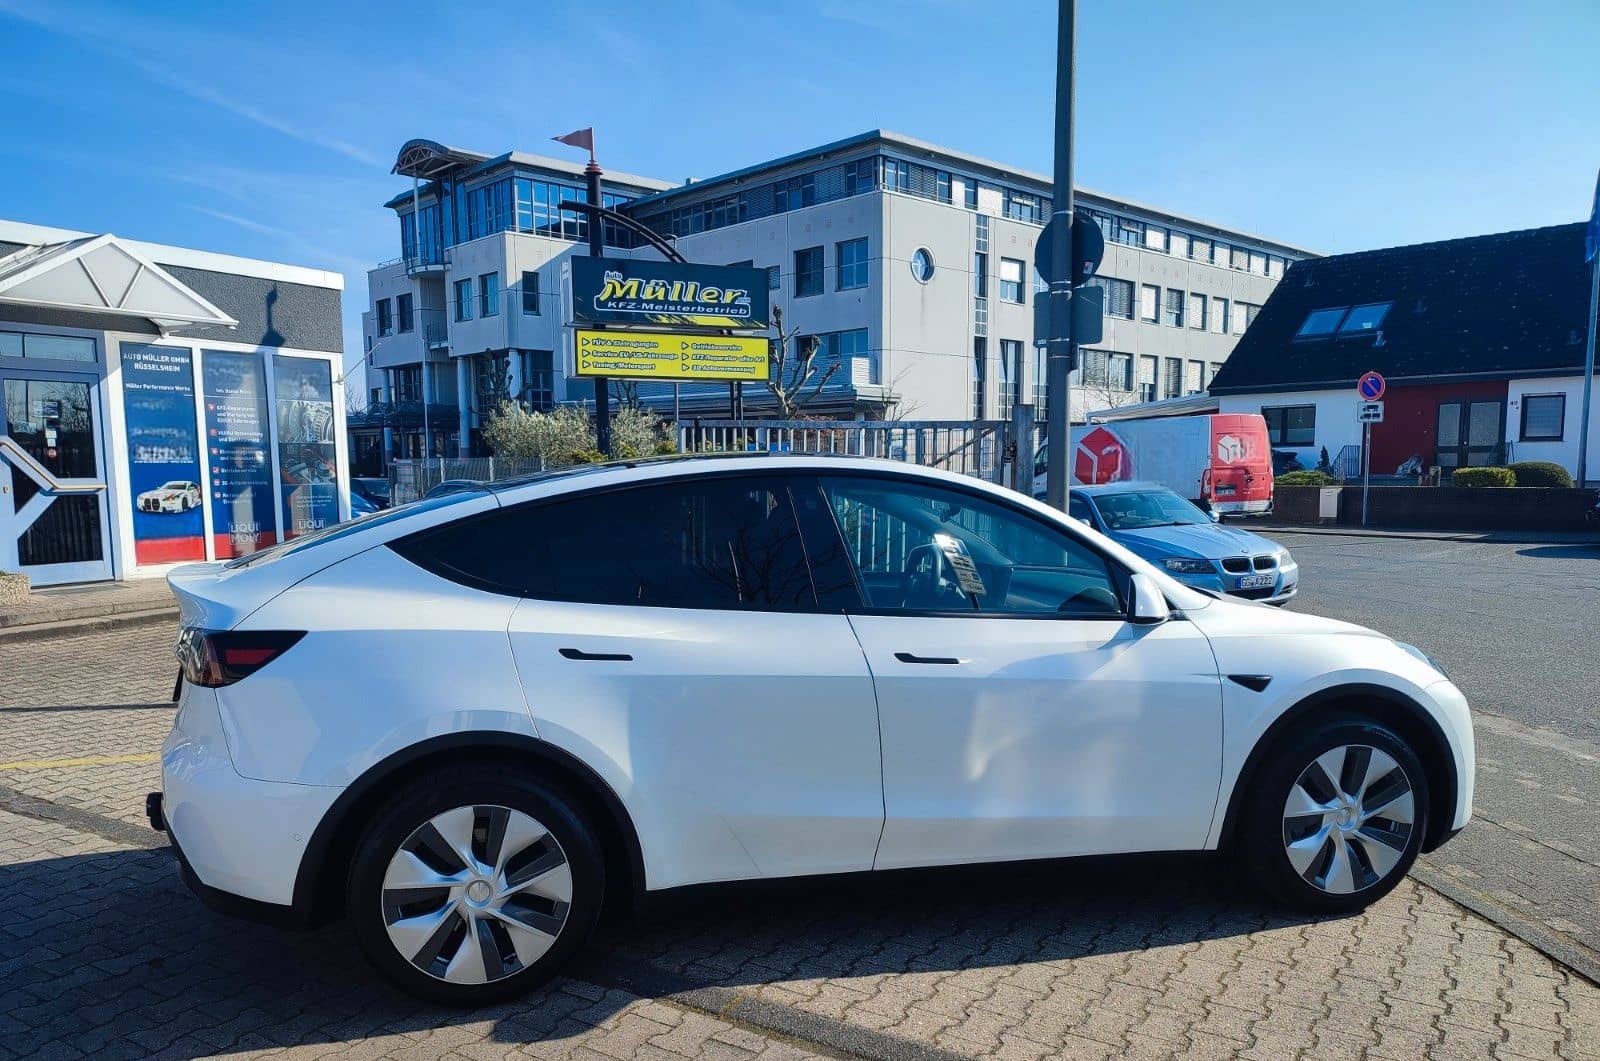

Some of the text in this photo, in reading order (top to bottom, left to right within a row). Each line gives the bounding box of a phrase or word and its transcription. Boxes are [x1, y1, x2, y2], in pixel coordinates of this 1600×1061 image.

[604, 270, 623, 280] Auto
[600, 278, 748, 305] Müller
[607, 301, 747, 315] KFZ-Meisterbetrieb
[592, 337, 606, 346] TÜV
[123, 352, 141, 361] AUTO
[142, 353, 170, 363] MÜLLER
[592, 350, 618, 358] Service
[134, 362, 181, 373] RÜSSELSHEIM
[125, 382, 142, 390] Müller
[229, 522, 259, 533] LIQUI
[298, 519, 325, 530] LIQUI
[230, 533, 260, 543] MOLY
